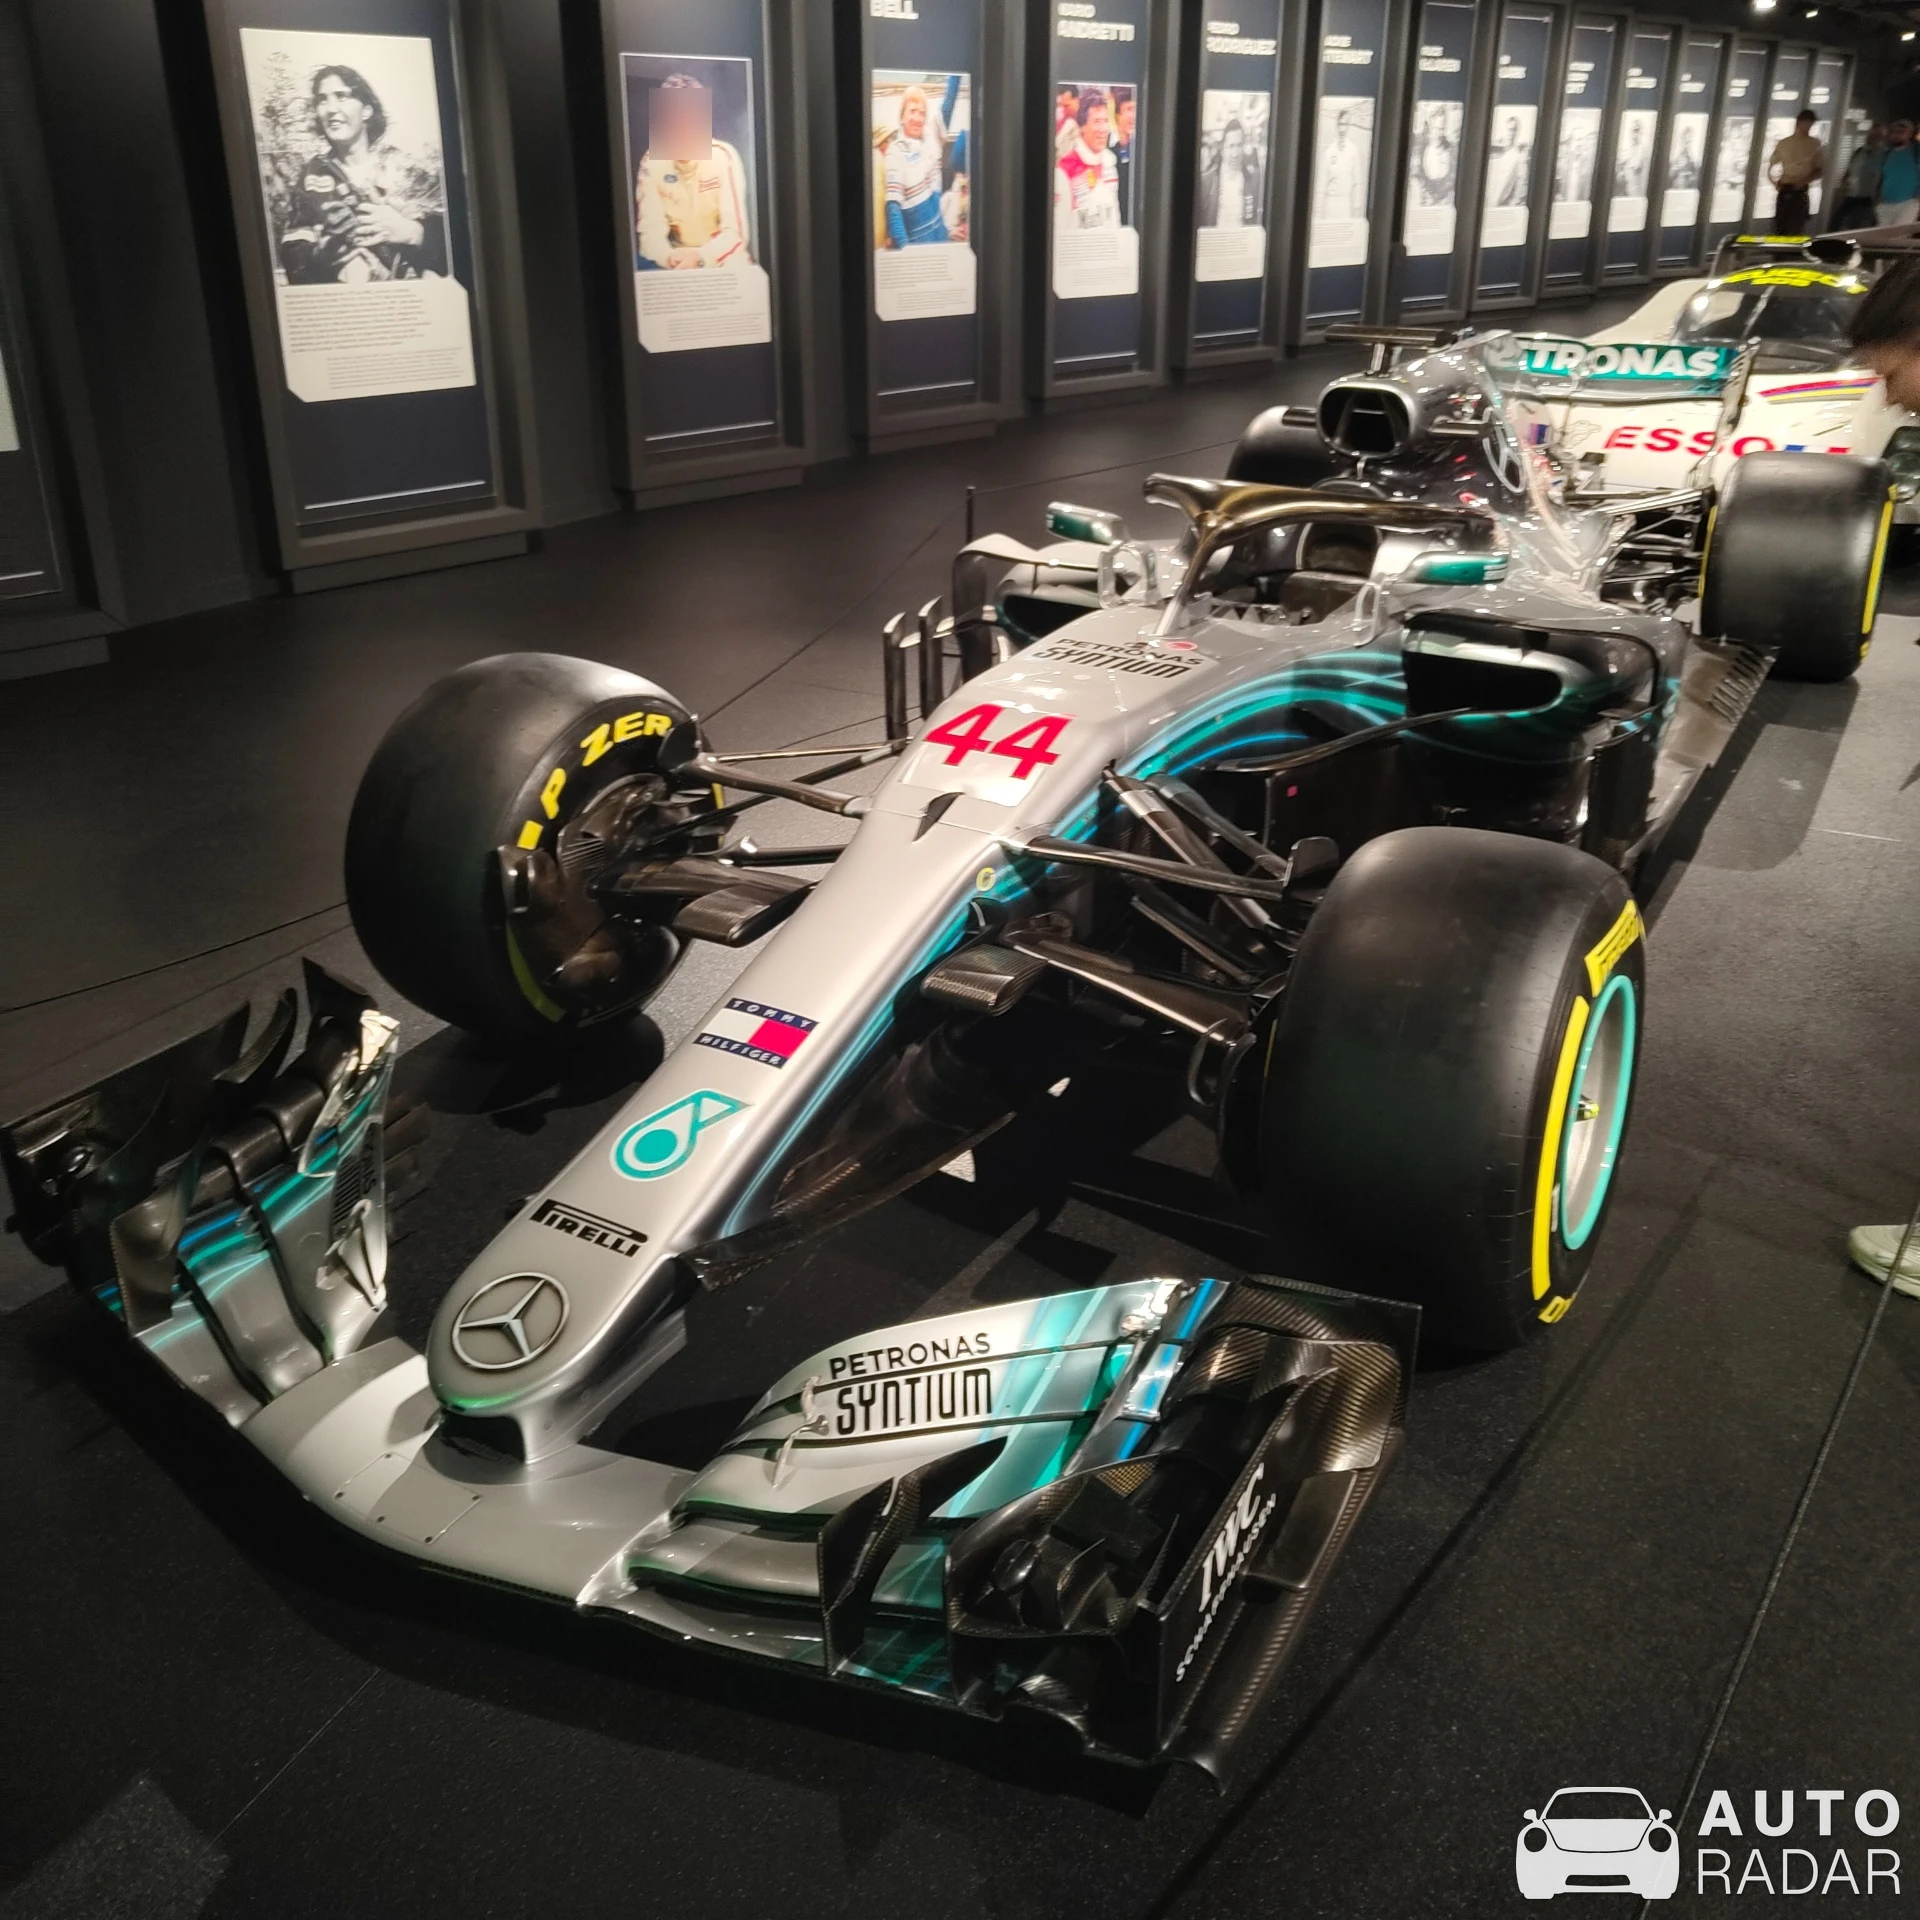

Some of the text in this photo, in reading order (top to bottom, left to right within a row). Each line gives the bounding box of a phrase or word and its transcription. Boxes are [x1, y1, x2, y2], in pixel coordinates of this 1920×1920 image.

[1033, 646, 1191, 679] SYNTIUM
[1056, 638, 1204, 666] PETRONAS
[580, 711, 672, 768] ZER
[924, 702, 1076, 781] 44
[732, 1000, 812, 1029] TOMMY
[700, 1035, 781, 1066] HILFIGER
[530, 1198, 648, 1258] PIRELLI
[829, 1332, 991, 1380] PETRONAS
[837, 1368, 992, 1436] SYNTIUM
[1199, 1462, 1264, 1613] IWC
